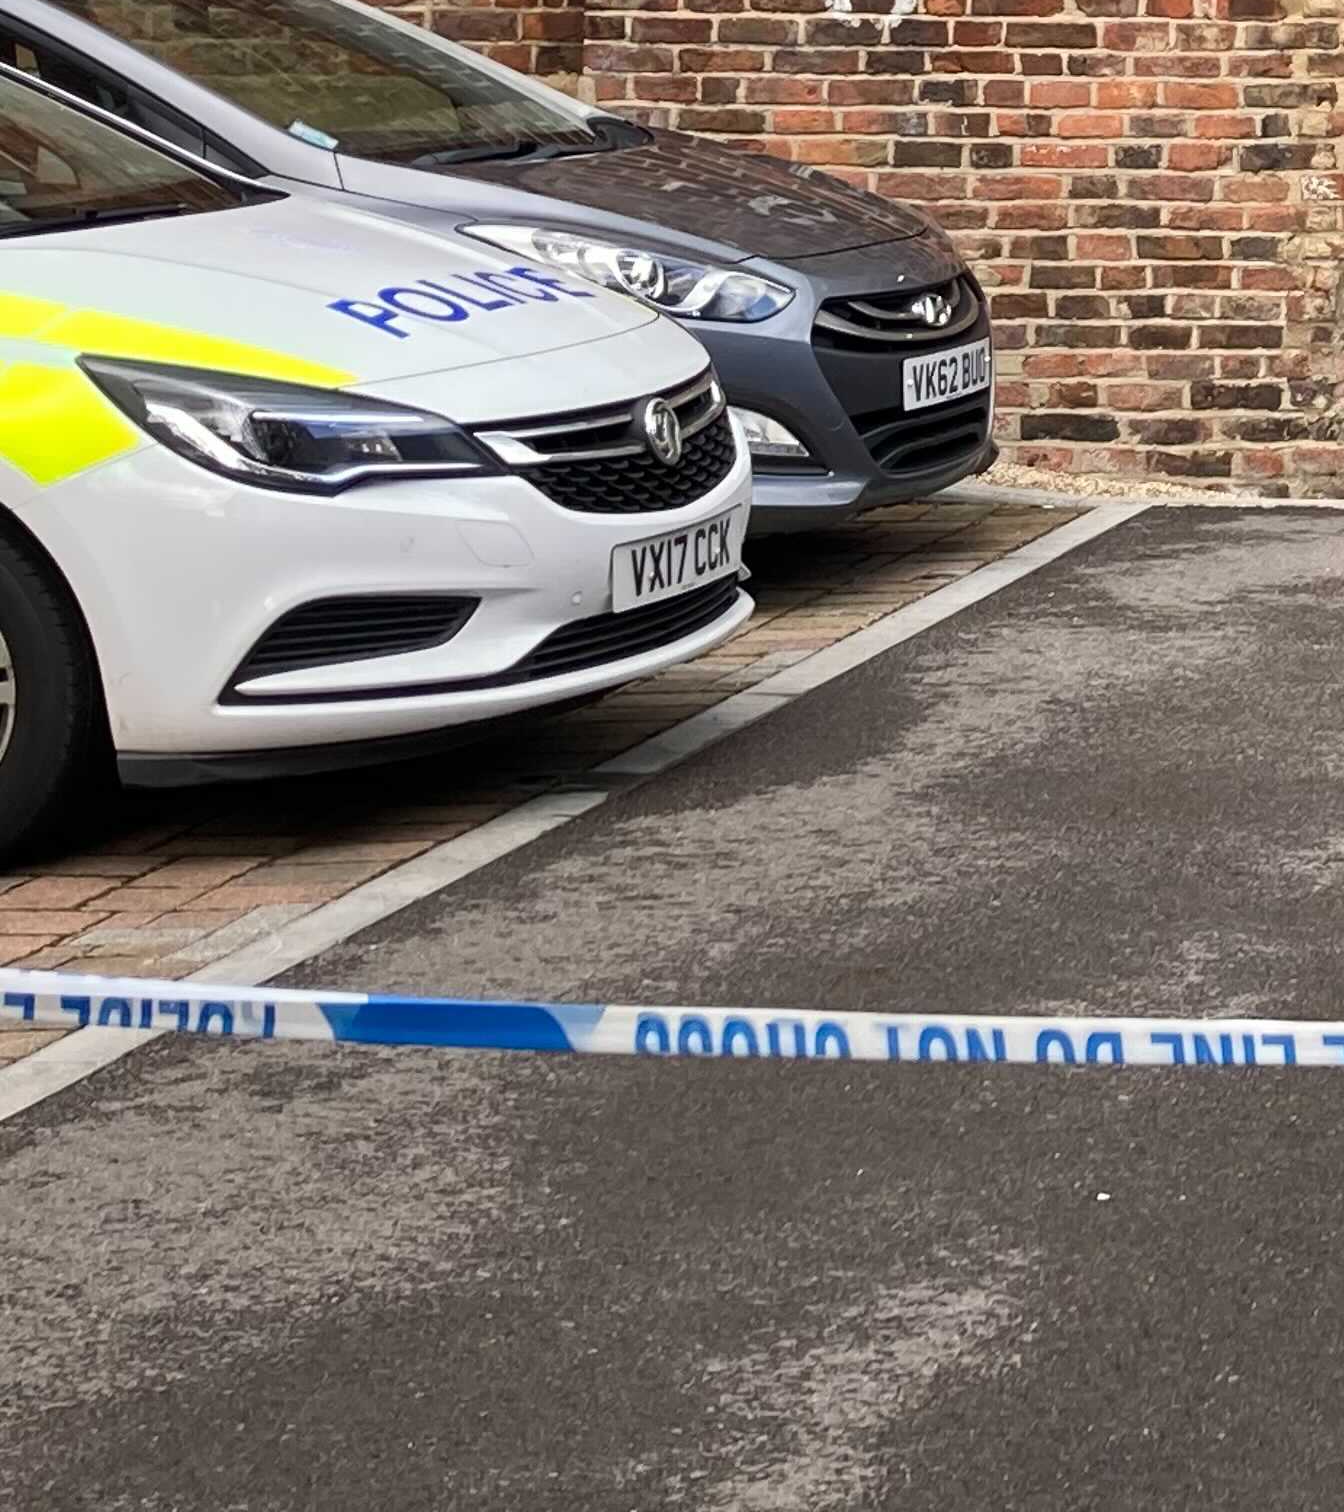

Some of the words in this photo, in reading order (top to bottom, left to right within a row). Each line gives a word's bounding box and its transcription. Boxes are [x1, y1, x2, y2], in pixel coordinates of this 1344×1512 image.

[325, 266, 597, 339] POLICE
[912, 355, 959, 402] VK62
[631, 534, 689, 597] VX17
[694, 517, 731, 576] CCK
